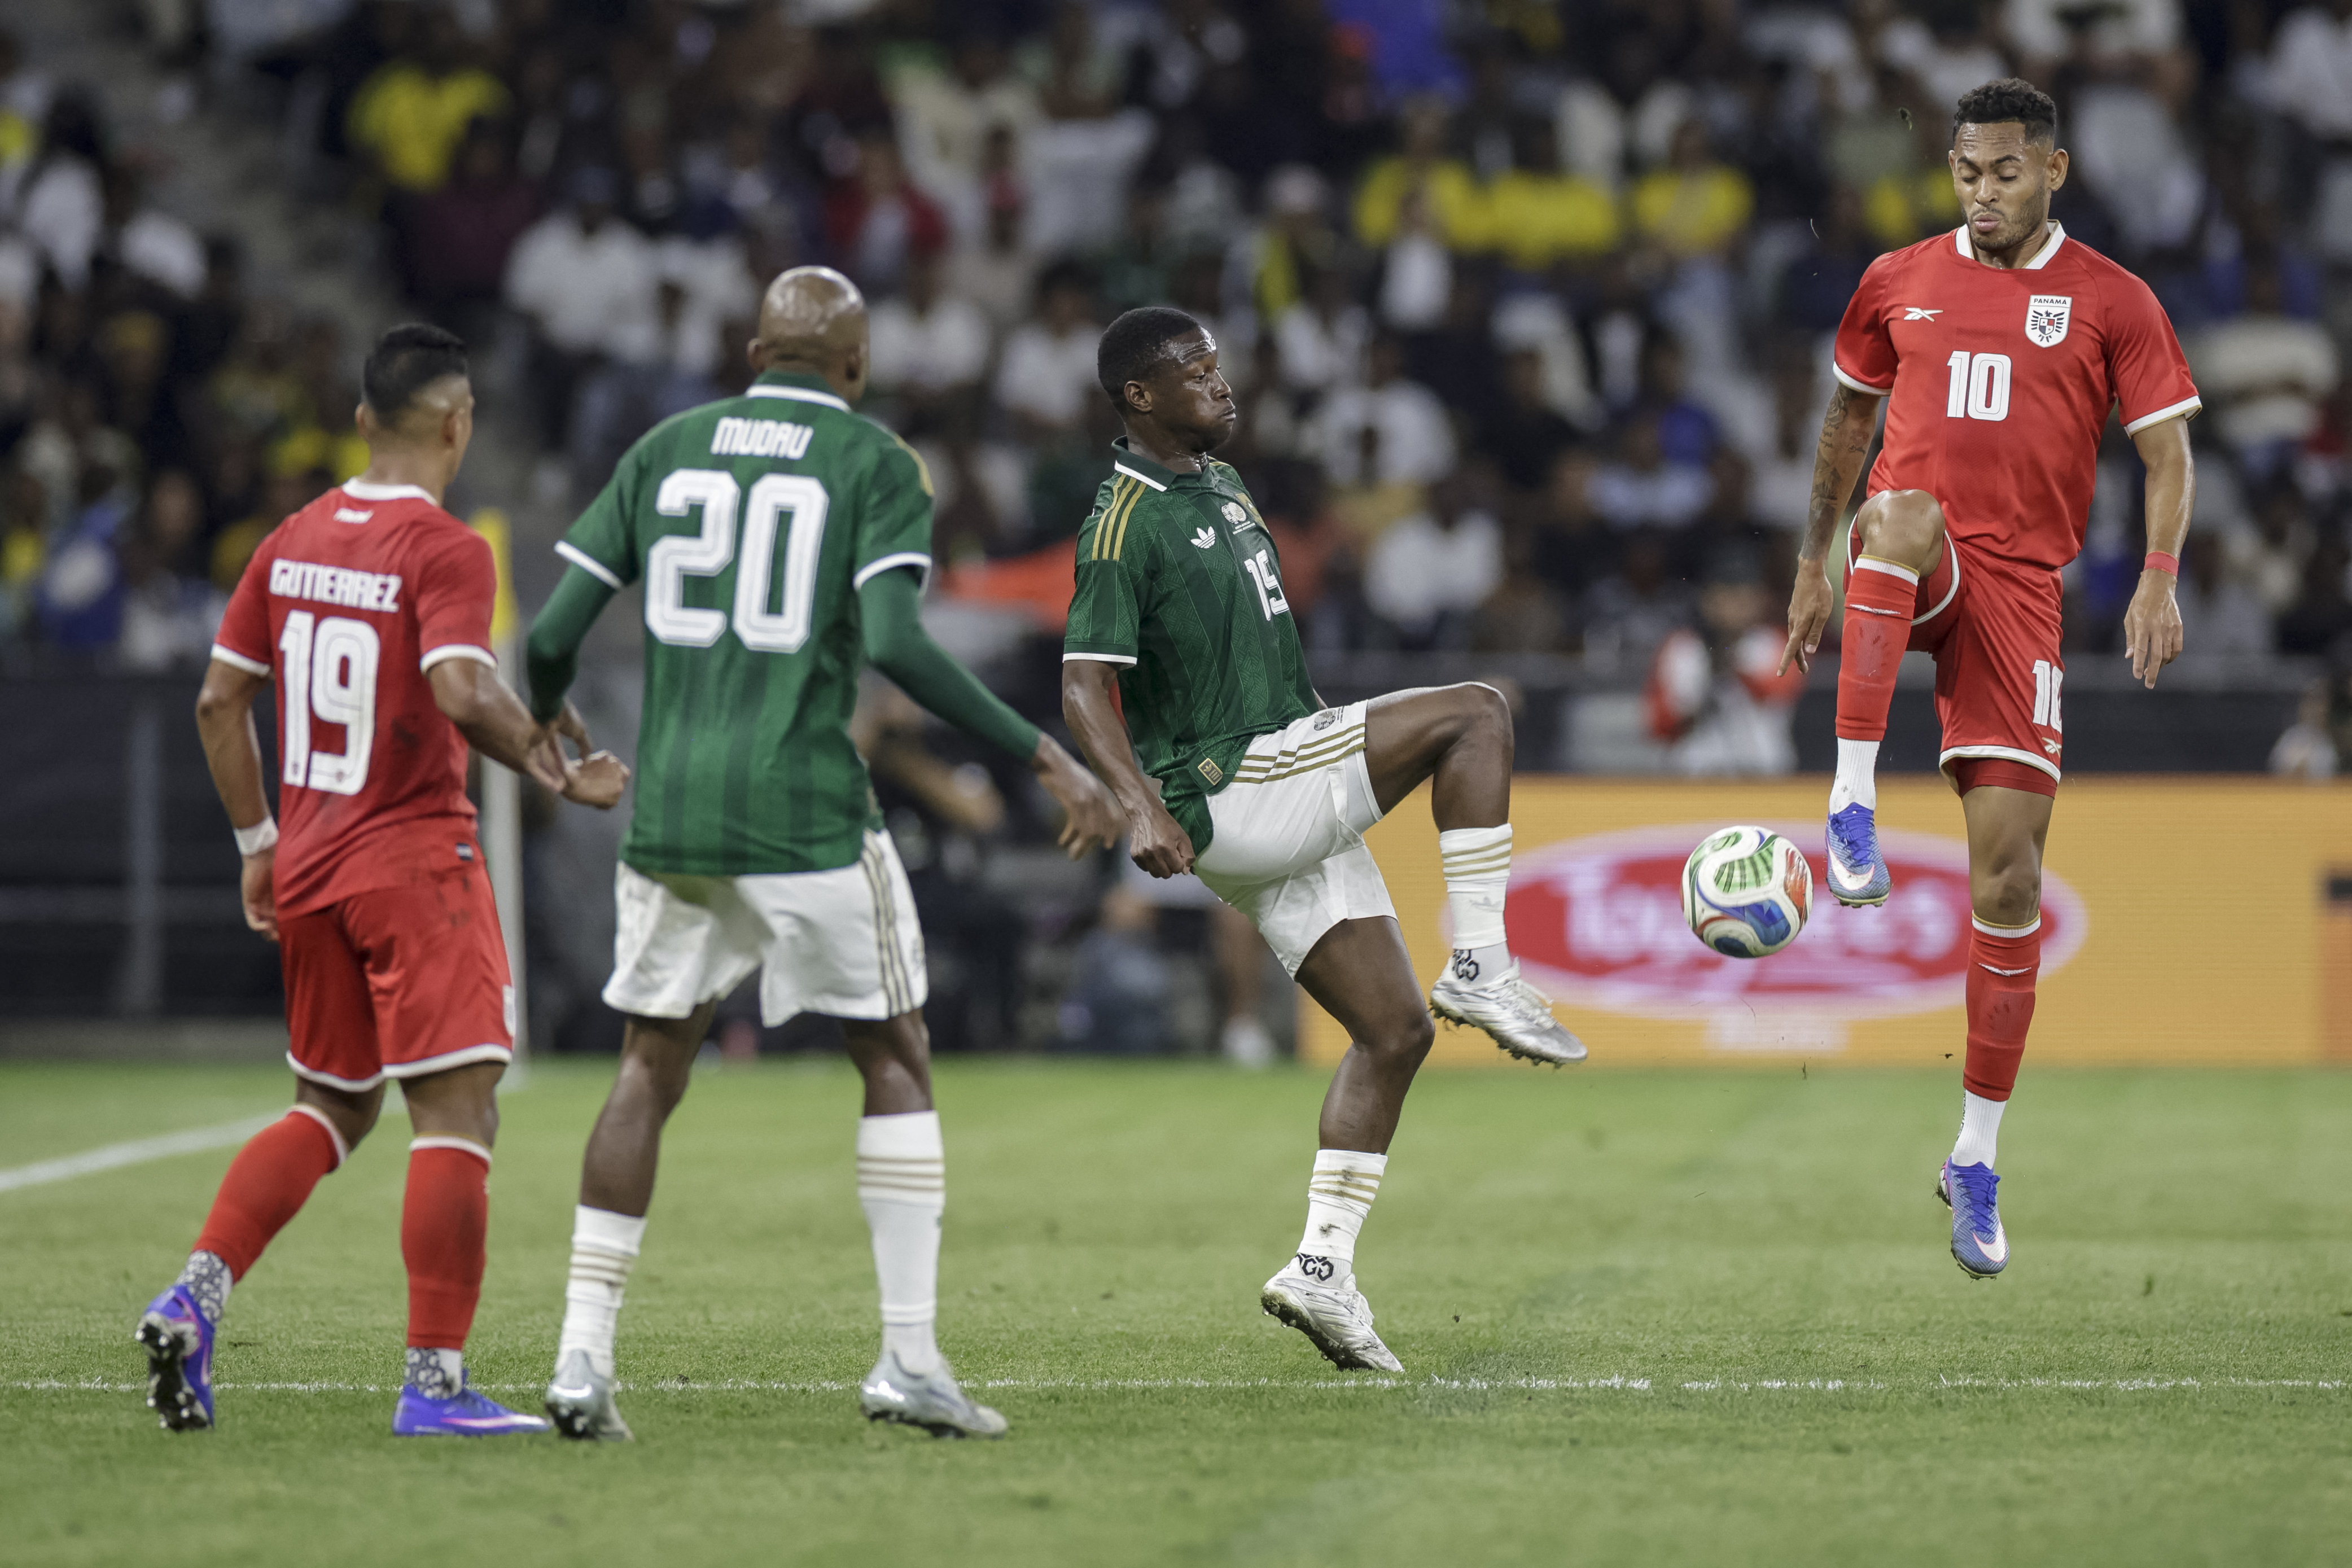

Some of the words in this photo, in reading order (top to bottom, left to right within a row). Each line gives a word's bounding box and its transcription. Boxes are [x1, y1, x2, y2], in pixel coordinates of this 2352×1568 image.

[1946, 350, 2013, 422] 10
[710, 417, 814, 460] MUDAU
[269, 558, 402, 613] GUTIERREZ
[645, 468, 830, 655] 20
[1243, 549, 1290, 621] 15
[279, 609, 380, 796] 19
